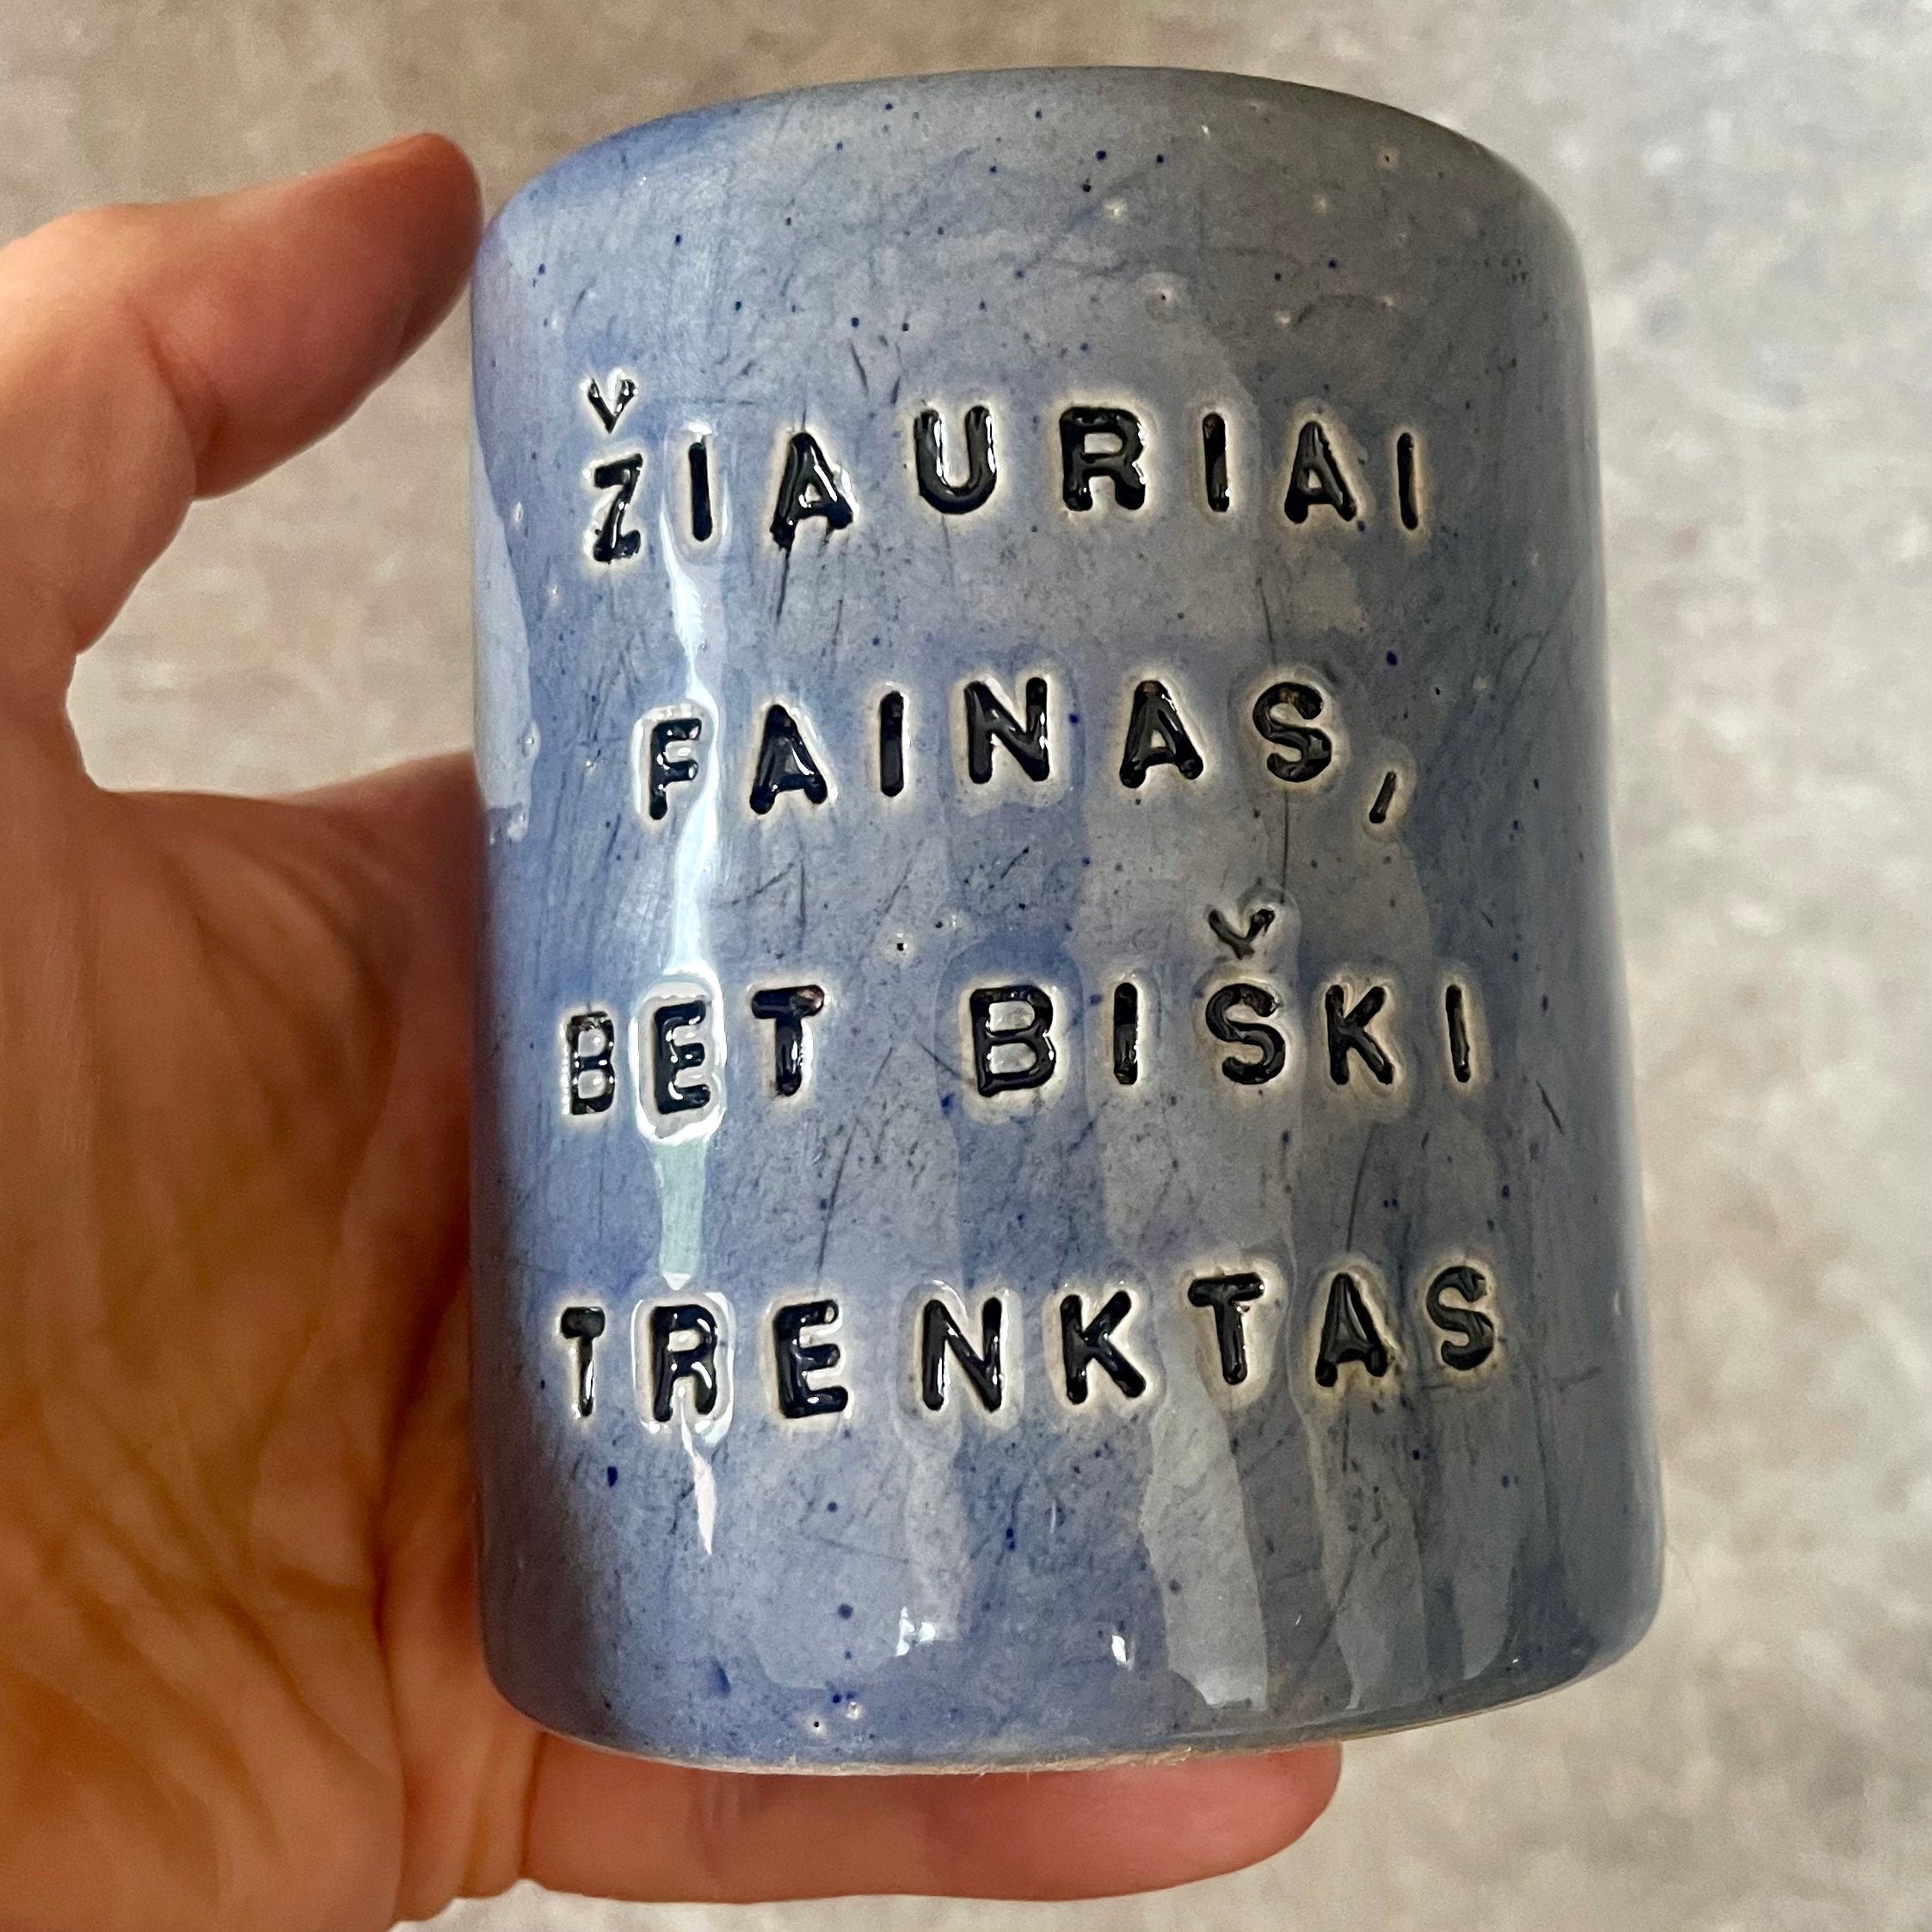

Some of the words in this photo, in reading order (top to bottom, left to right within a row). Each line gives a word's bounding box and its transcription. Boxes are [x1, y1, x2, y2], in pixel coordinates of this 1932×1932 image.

[586, 377, 1420, 563] ŽIAURIAI
[648, 676, 1398, 823] FAINAS,
[564, 986, 824, 1115] BET
[969, 908, 1471, 1097] BIŠKI
[561, 1266, 1495, 1421] TRENKTAS
